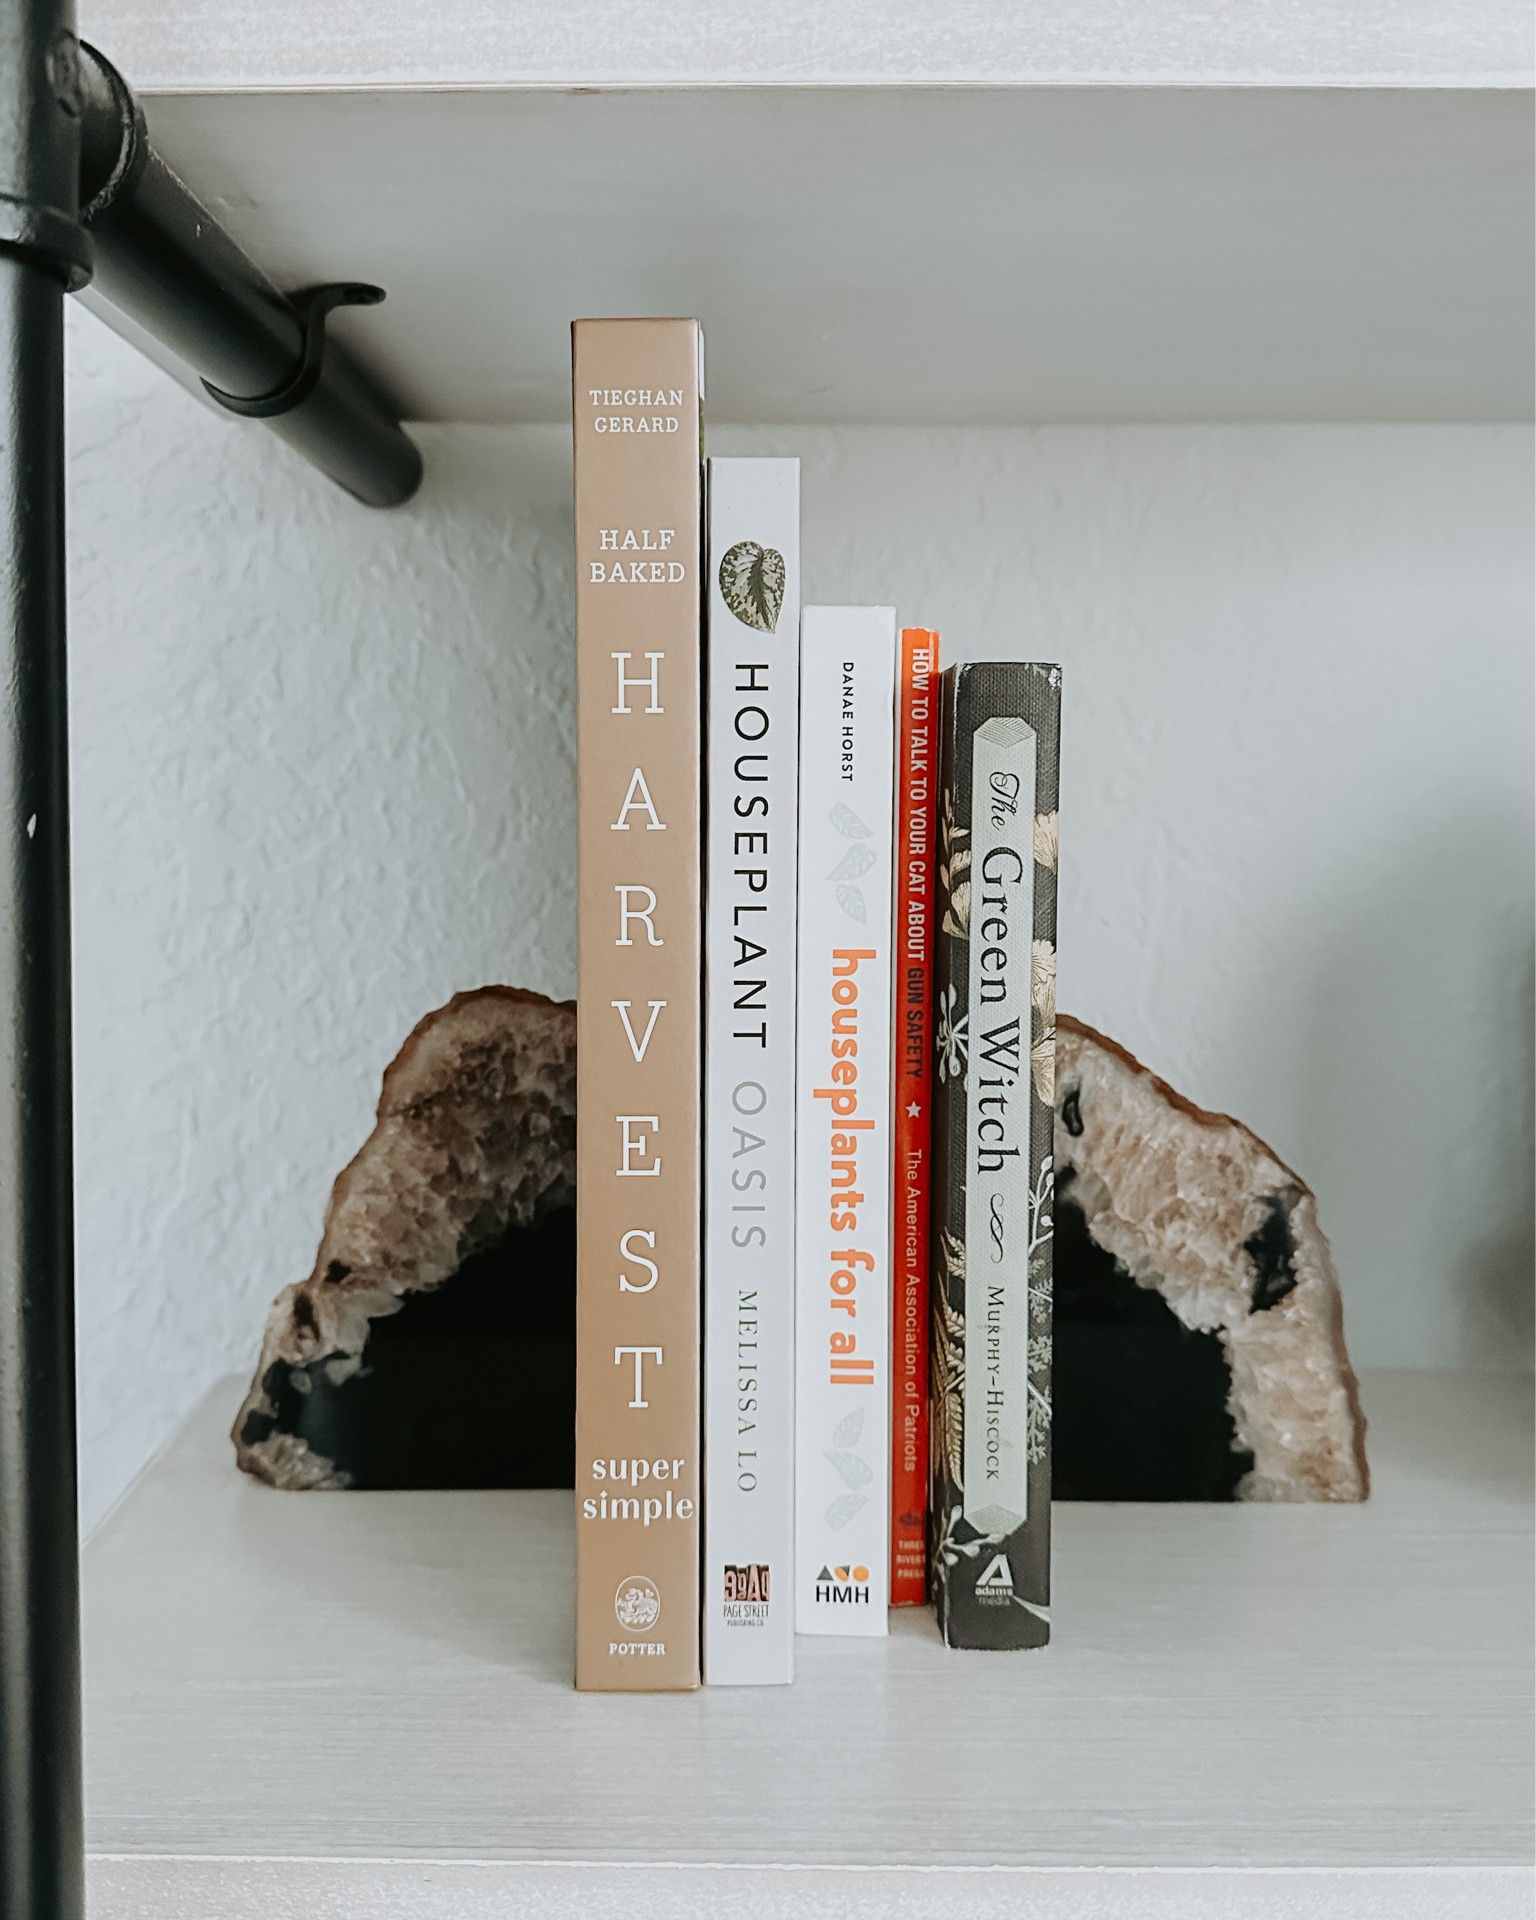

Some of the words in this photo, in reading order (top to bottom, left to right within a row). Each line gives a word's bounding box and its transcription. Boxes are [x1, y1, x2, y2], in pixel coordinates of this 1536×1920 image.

[589, 389, 684, 407] TIEGHAN
[594, 417, 680, 434] GERARD
[599, 529, 676, 551] HALF
[589, 562, 686, 584] BAKED
[842, 662, 855, 719] DANAE
[911, 648, 930, 691] HOW
[911, 697, 929, 720] TO
[841, 725, 854, 782] HORST
[910, 726, 928, 772] TALK
[910, 778, 927, 801] TO
[989, 771, 1020, 832] The
[909, 806, 927, 856] YOUR
[732, 664, 770, 1049] HOUSEPLANT
[908, 861, 926, 895] CAT
[907, 900, 925, 962] ABOUT
[981, 846, 1023, 1006] Green
[906, 967, 924, 1004] GUN
[610, 652, 667, 1408] HARVEST
[906, 1010, 923, 1079] SAFETY
[813, 949, 876, 1231] houseplants
[977, 1015, 1021, 1175] Witch
[731, 1081, 768, 1249] OASIS
[907, 1148, 922, 1181] The
[906, 1186, 921, 1268] American
[830, 1249, 875, 1318] for
[904, 1273, 921, 1376] Association
[737, 1289, 759, 1436] MELISSA
[830, 1331, 874, 1385] all
[904, 1381, 919, 1398] of
[904, 1403, 920, 1473] Patriots
[591, 1457, 685, 1487] super
[737, 1451, 758, 1493] LO
[582, 1490, 694, 1527] simple
[723, 1604, 742, 1618] PAGE
[744, 1603, 769, 1618] STREET
[816, 1586, 869, 1604] HMH
[975, 1586, 1013, 1595] adams
[609, 1643, 666, 1656] POTTER
